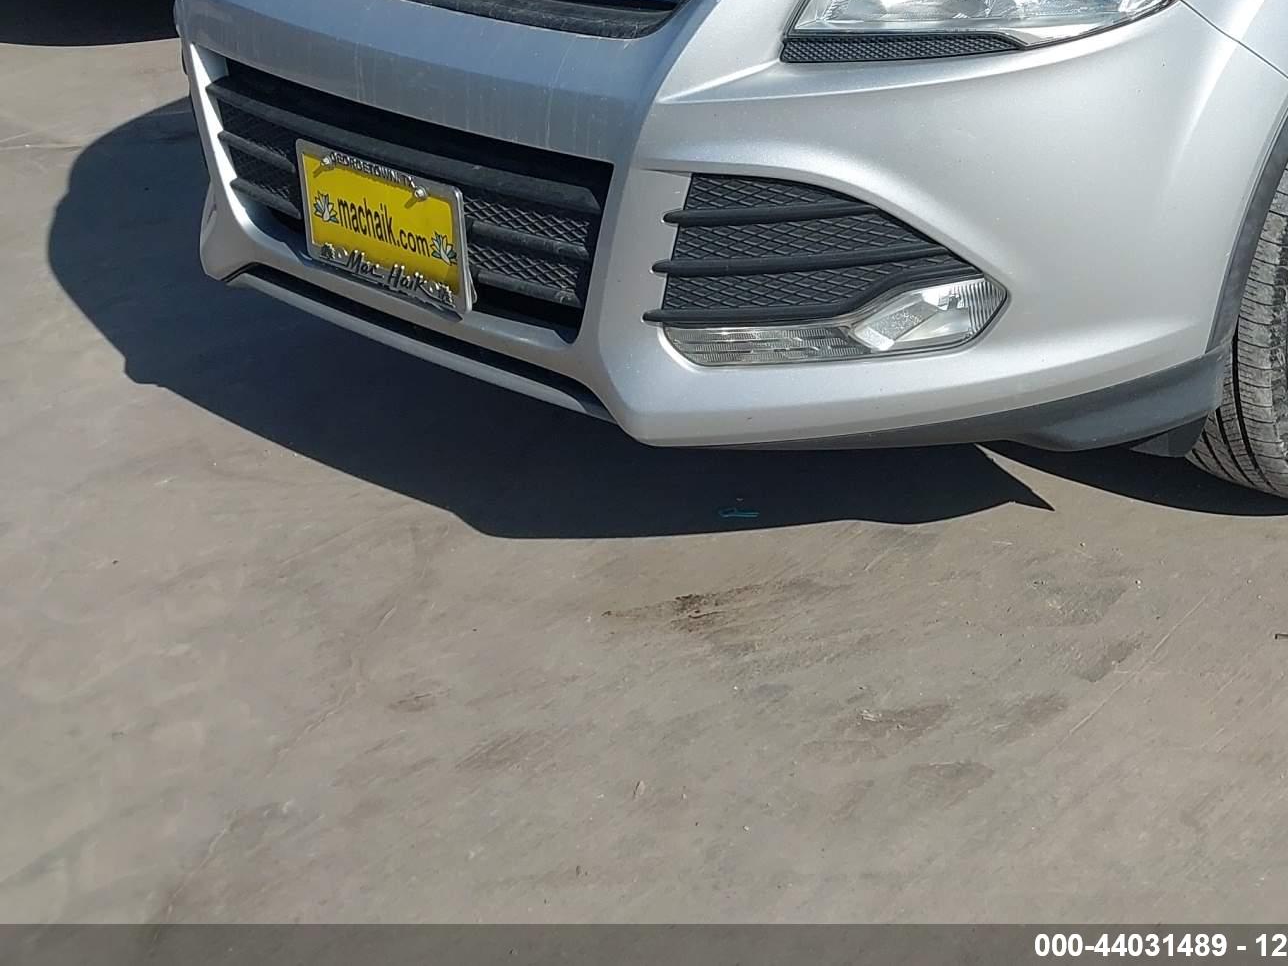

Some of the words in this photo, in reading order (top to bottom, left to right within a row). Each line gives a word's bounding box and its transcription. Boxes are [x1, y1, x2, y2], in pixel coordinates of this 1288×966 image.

[336, 197, 430, 258] machaik.com
[346, 250, 384, 278] Mac
[387, 264, 431, 293] Haik
